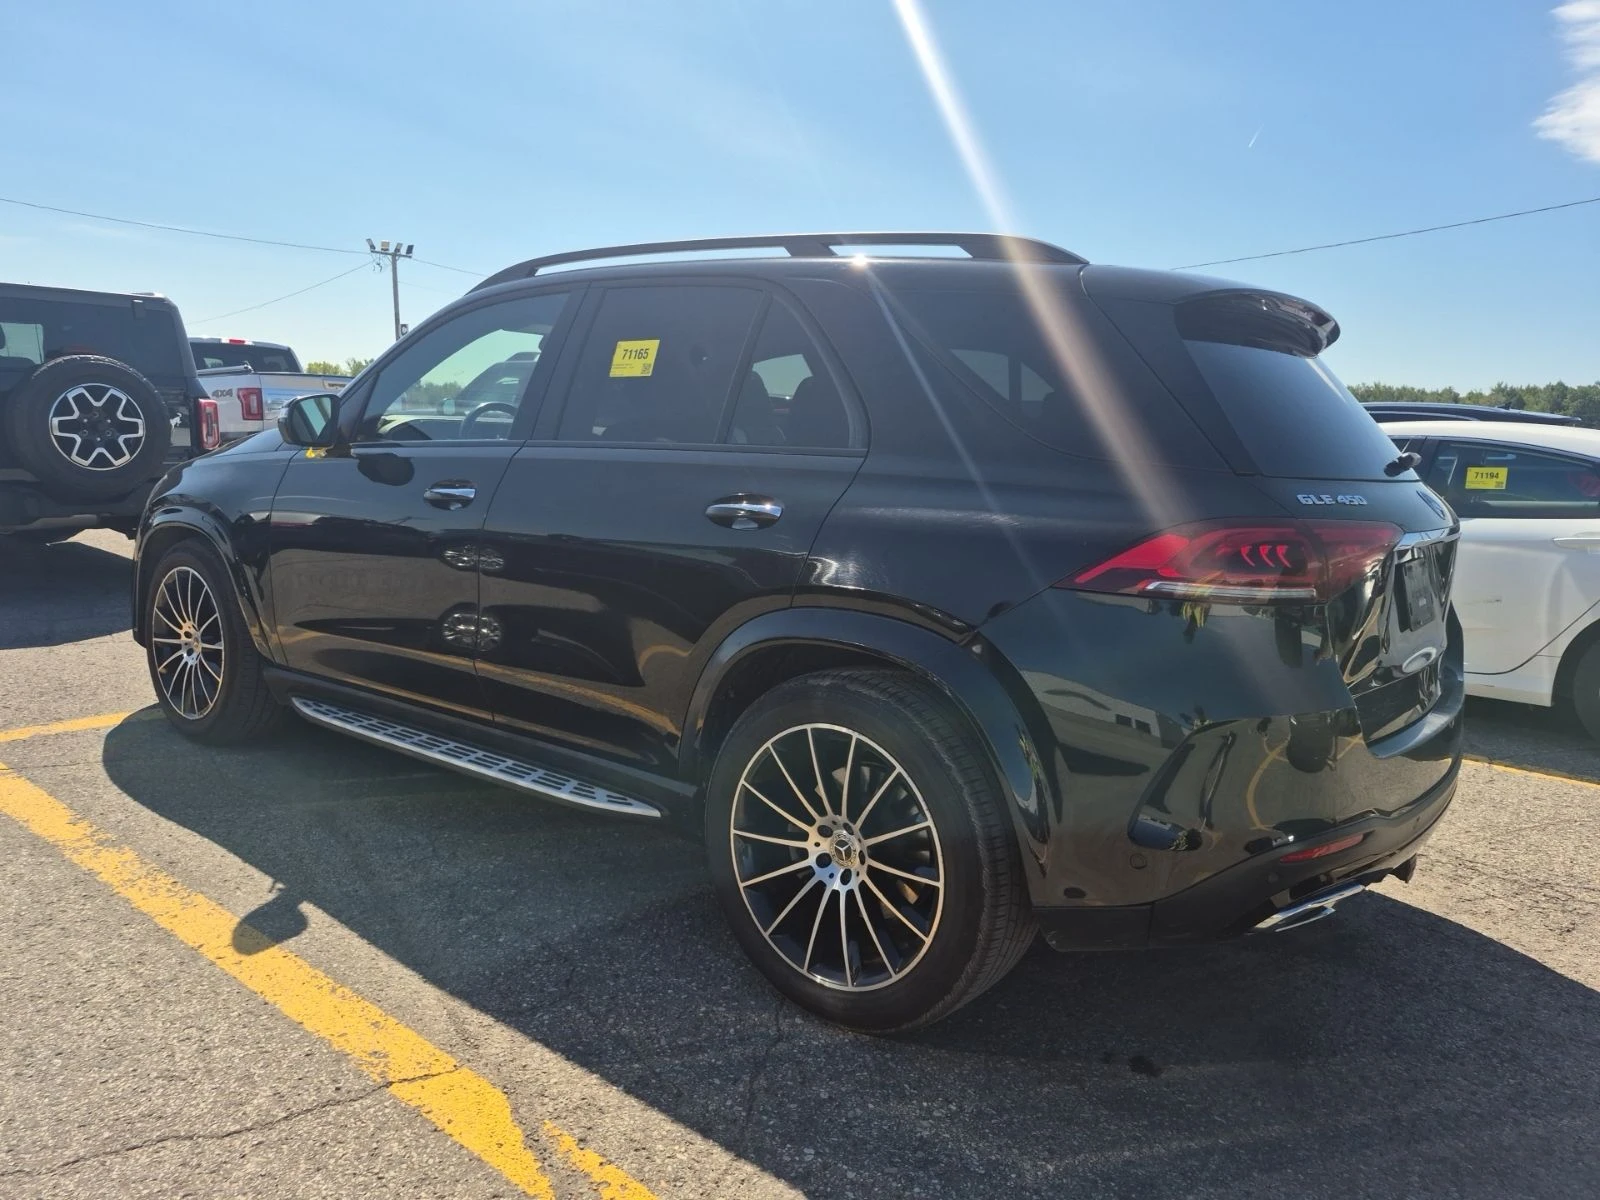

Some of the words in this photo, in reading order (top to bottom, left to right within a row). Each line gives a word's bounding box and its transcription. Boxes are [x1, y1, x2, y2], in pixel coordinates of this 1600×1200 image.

[622, 348, 650, 360] 71165
[1474, 471, 1500, 479] 71194
[1296, 494, 1336, 505] GLE
[1336, 494, 1368, 505] 450
